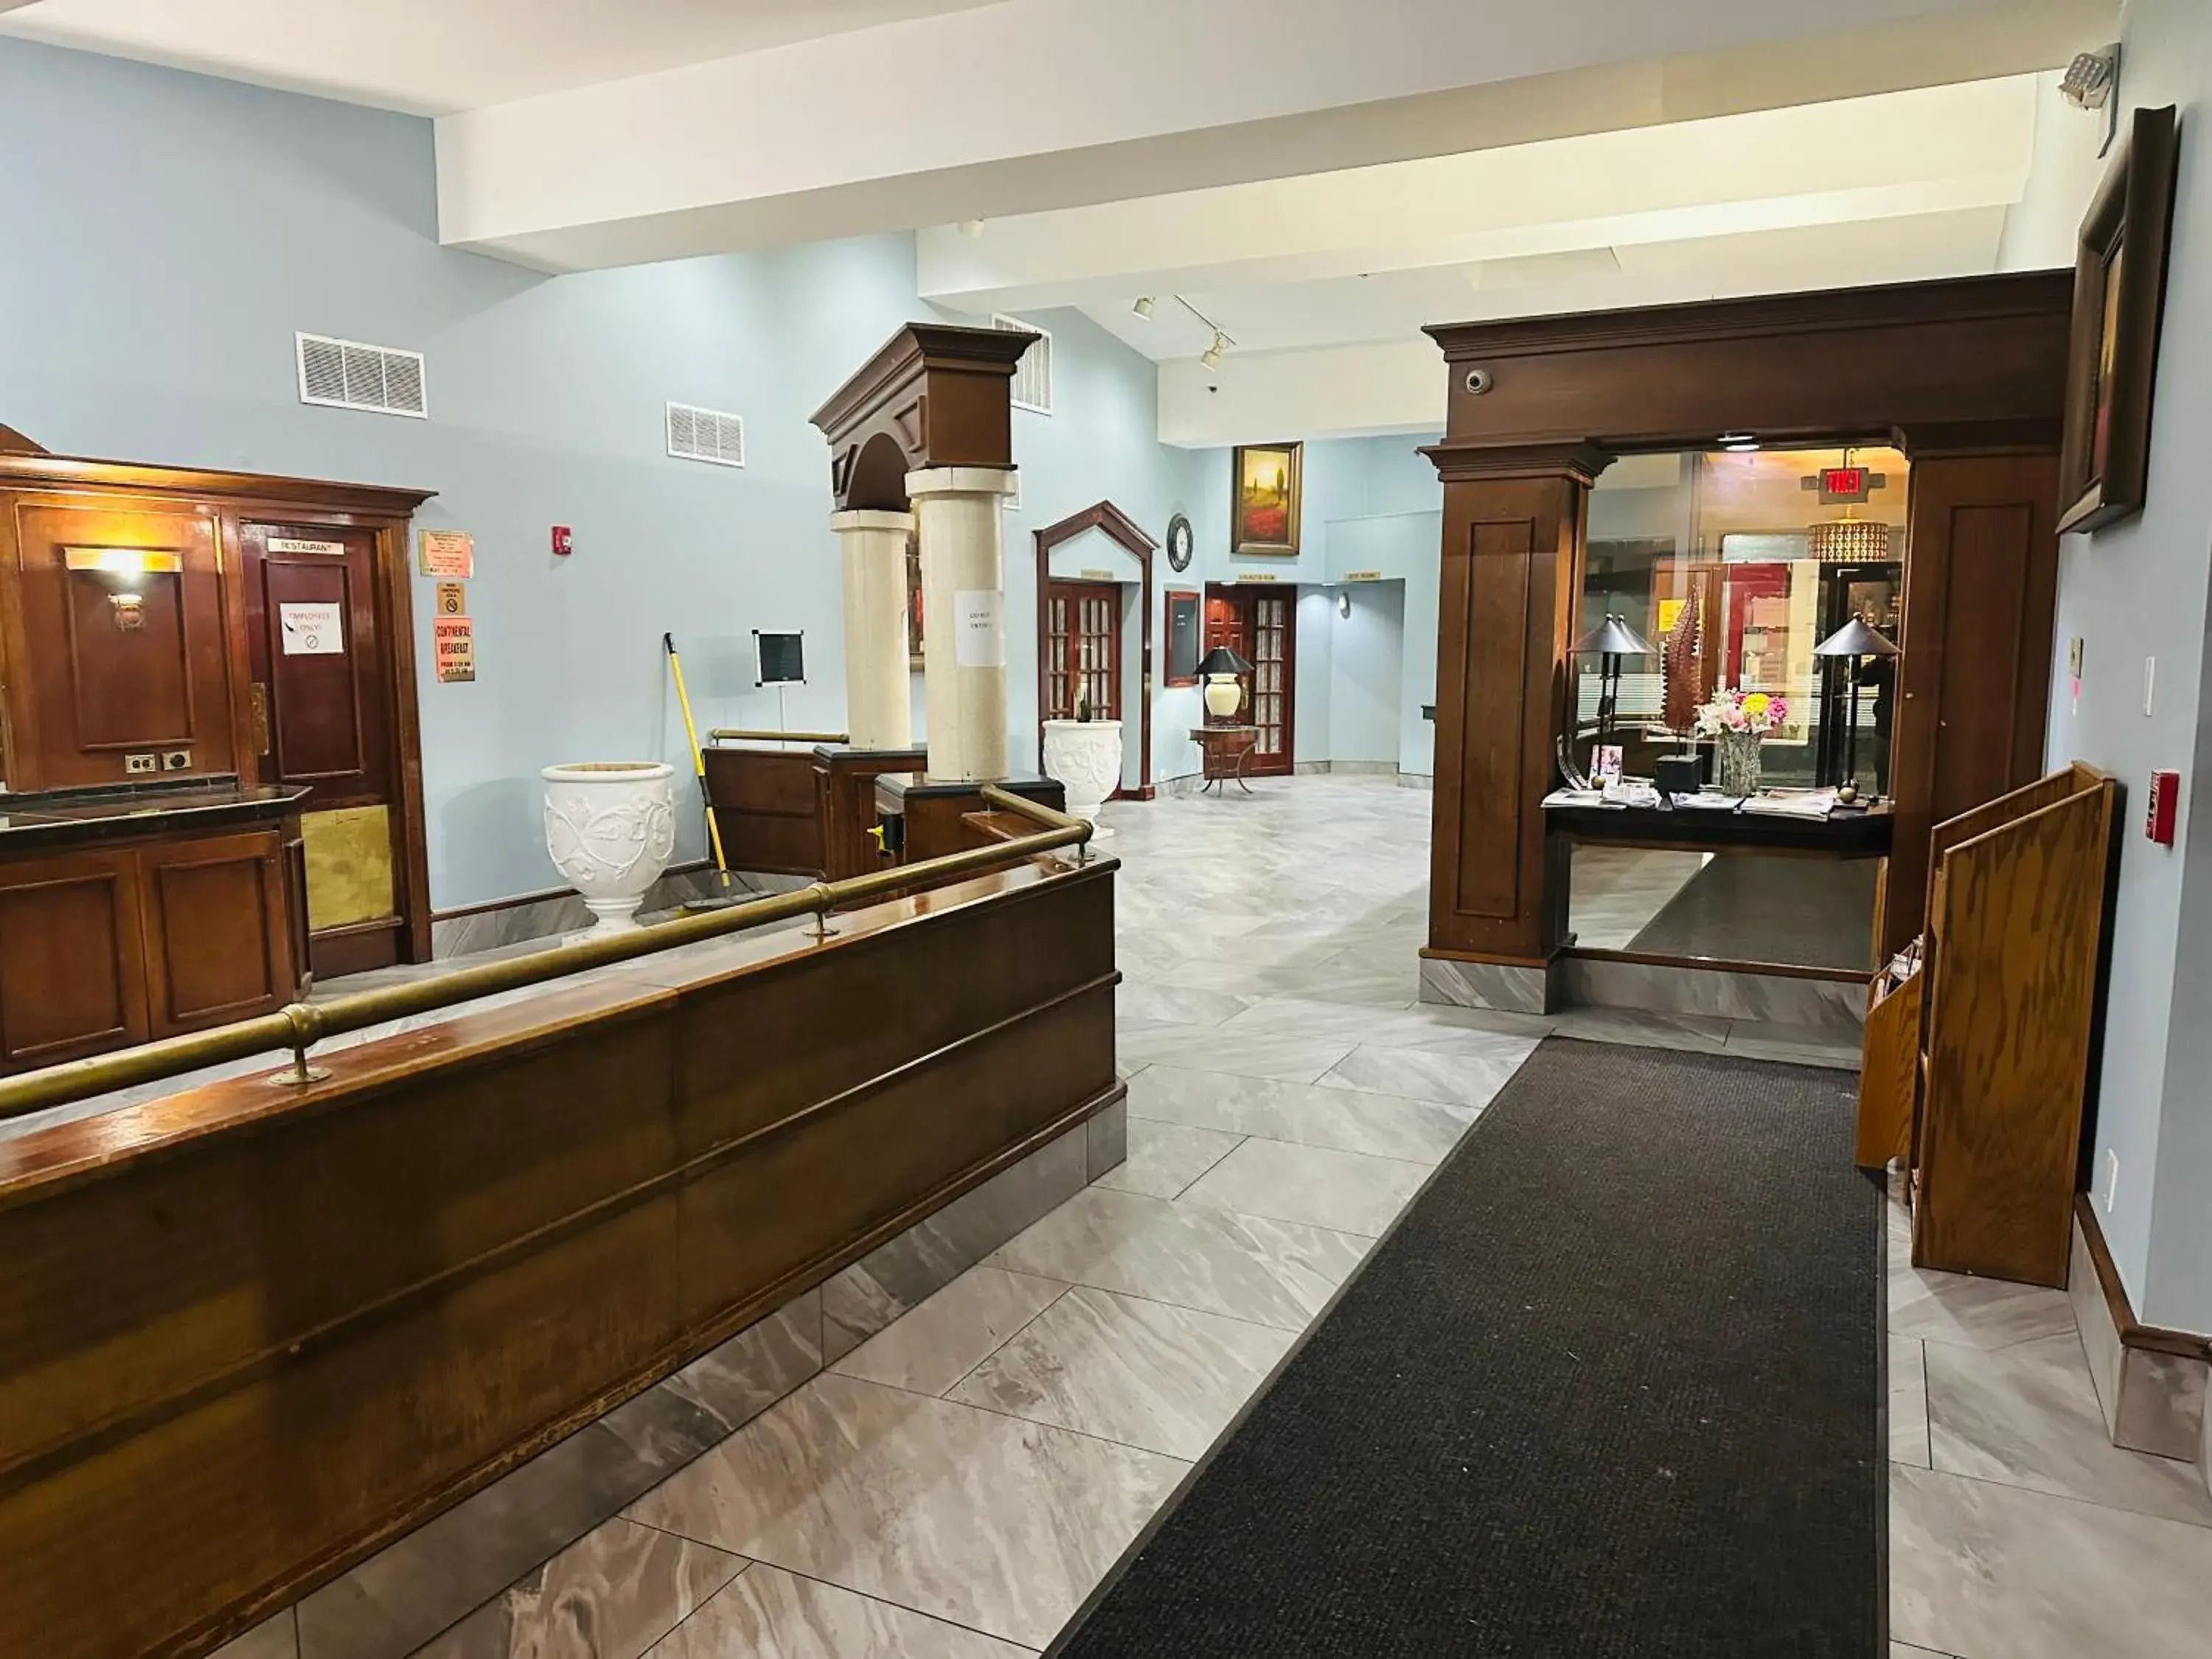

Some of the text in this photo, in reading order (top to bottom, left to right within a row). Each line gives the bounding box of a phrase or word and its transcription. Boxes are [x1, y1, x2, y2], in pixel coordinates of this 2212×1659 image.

[281, 541, 331, 552] RESTAURANT
[437, 625, 470, 637] CONTINENTAL
[440, 642, 467, 655] BREAKFAST
